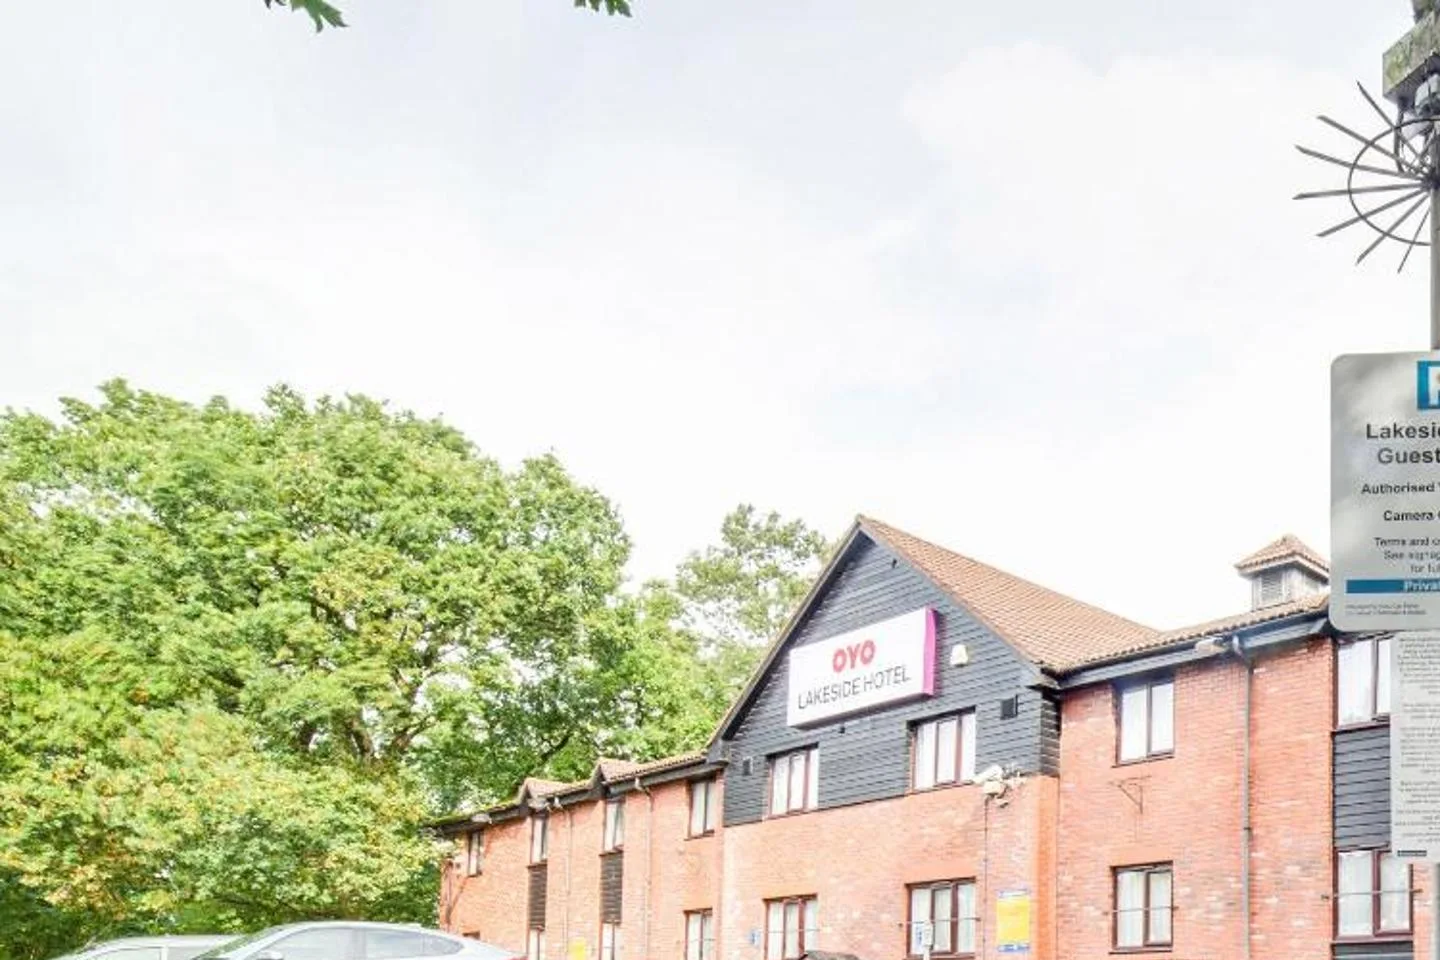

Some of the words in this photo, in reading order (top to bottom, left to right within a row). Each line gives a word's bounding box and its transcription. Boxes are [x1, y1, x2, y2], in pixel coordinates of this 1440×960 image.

[1361, 482, 1435, 495] Authorised
[1383, 509, 1433, 521] Camera
[1374, 537, 1406, 547] Terms
[1409, 536, 1429, 546] and
[832, 639, 876, 674] OYO
[797, 677, 861, 710] LAKESIDE
[863, 665, 911, 692] HOTEL
